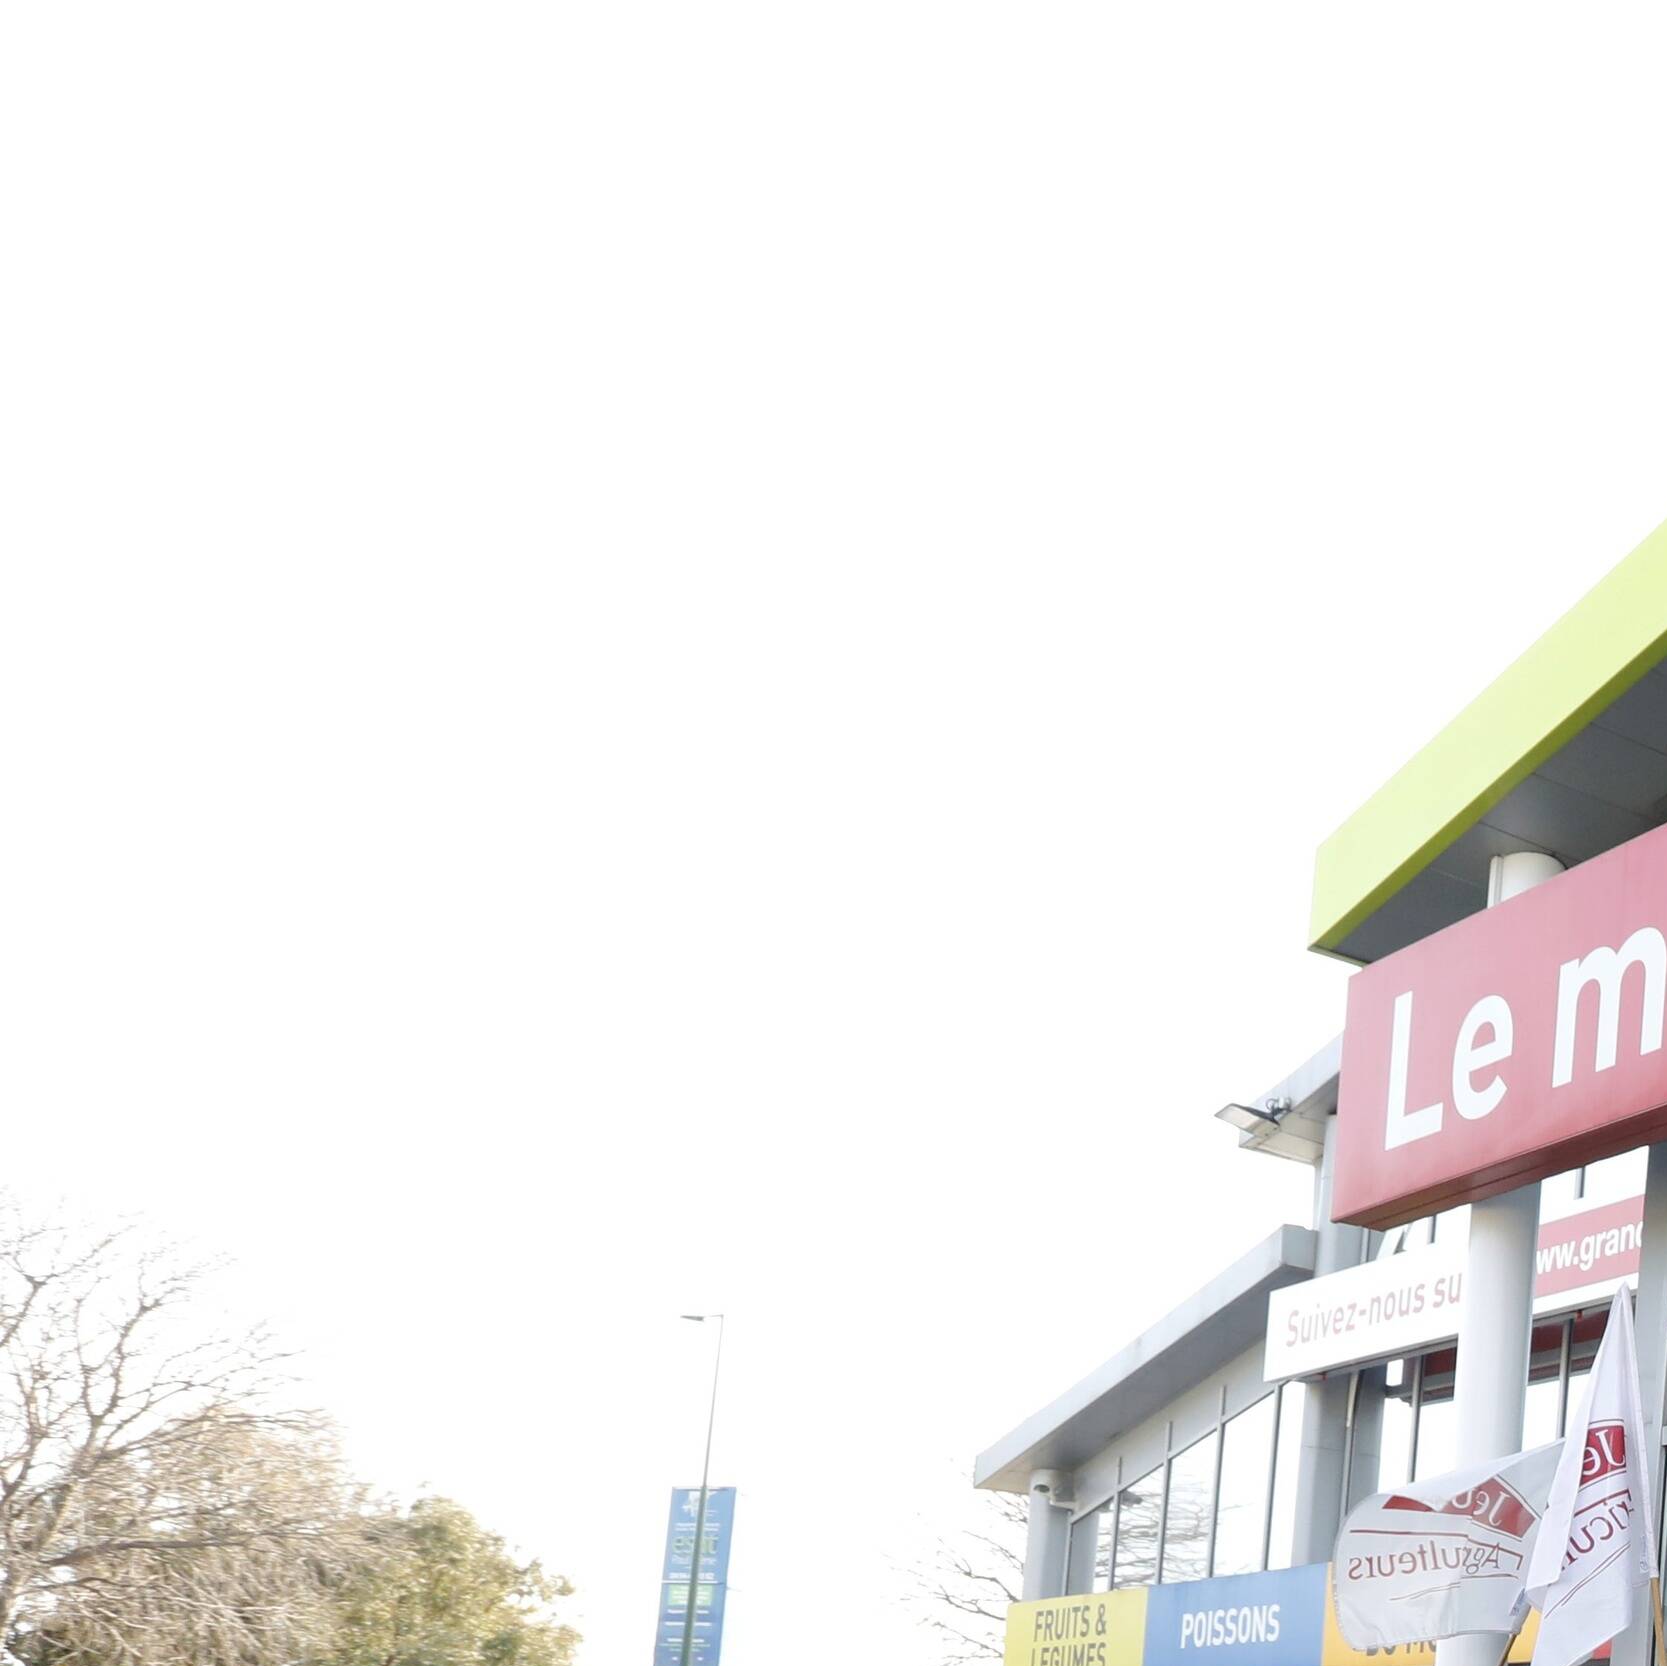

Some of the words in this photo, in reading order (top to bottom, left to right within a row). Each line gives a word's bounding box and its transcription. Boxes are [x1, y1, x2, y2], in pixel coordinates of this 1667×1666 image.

[1383, 990, 1515, 1151] Le
[1286, 1280, 1426, 1349] Suivez-nous
[1033, 1605, 1091, 1643] FRUITS
[1095, 1603, 1107, 1638] &
[1180, 1603, 1281, 1649] POISSONS
